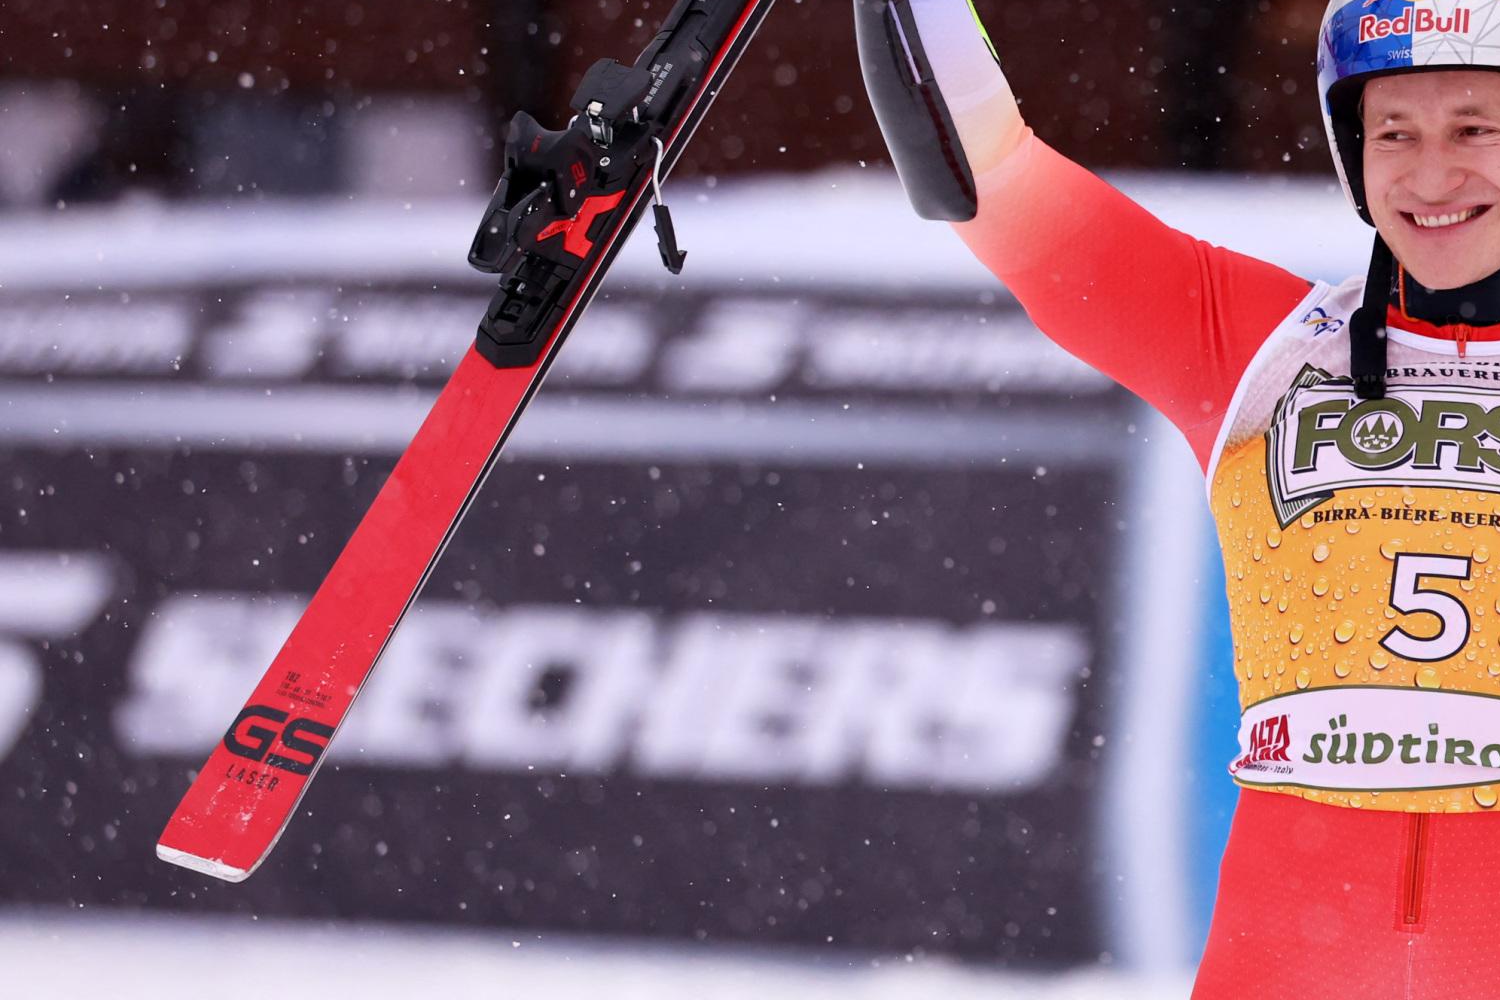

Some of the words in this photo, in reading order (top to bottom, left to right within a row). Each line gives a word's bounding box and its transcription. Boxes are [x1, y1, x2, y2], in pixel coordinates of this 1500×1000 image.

[1359, 8, 1412, 42] Red
[1414, 7, 1471, 34] Bull
[1378, 551, 1472, 662] 5
[224, 704, 336, 776] GS
[1249, 714, 1290, 757] ALTA
[225, 764, 280, 792] LASER
